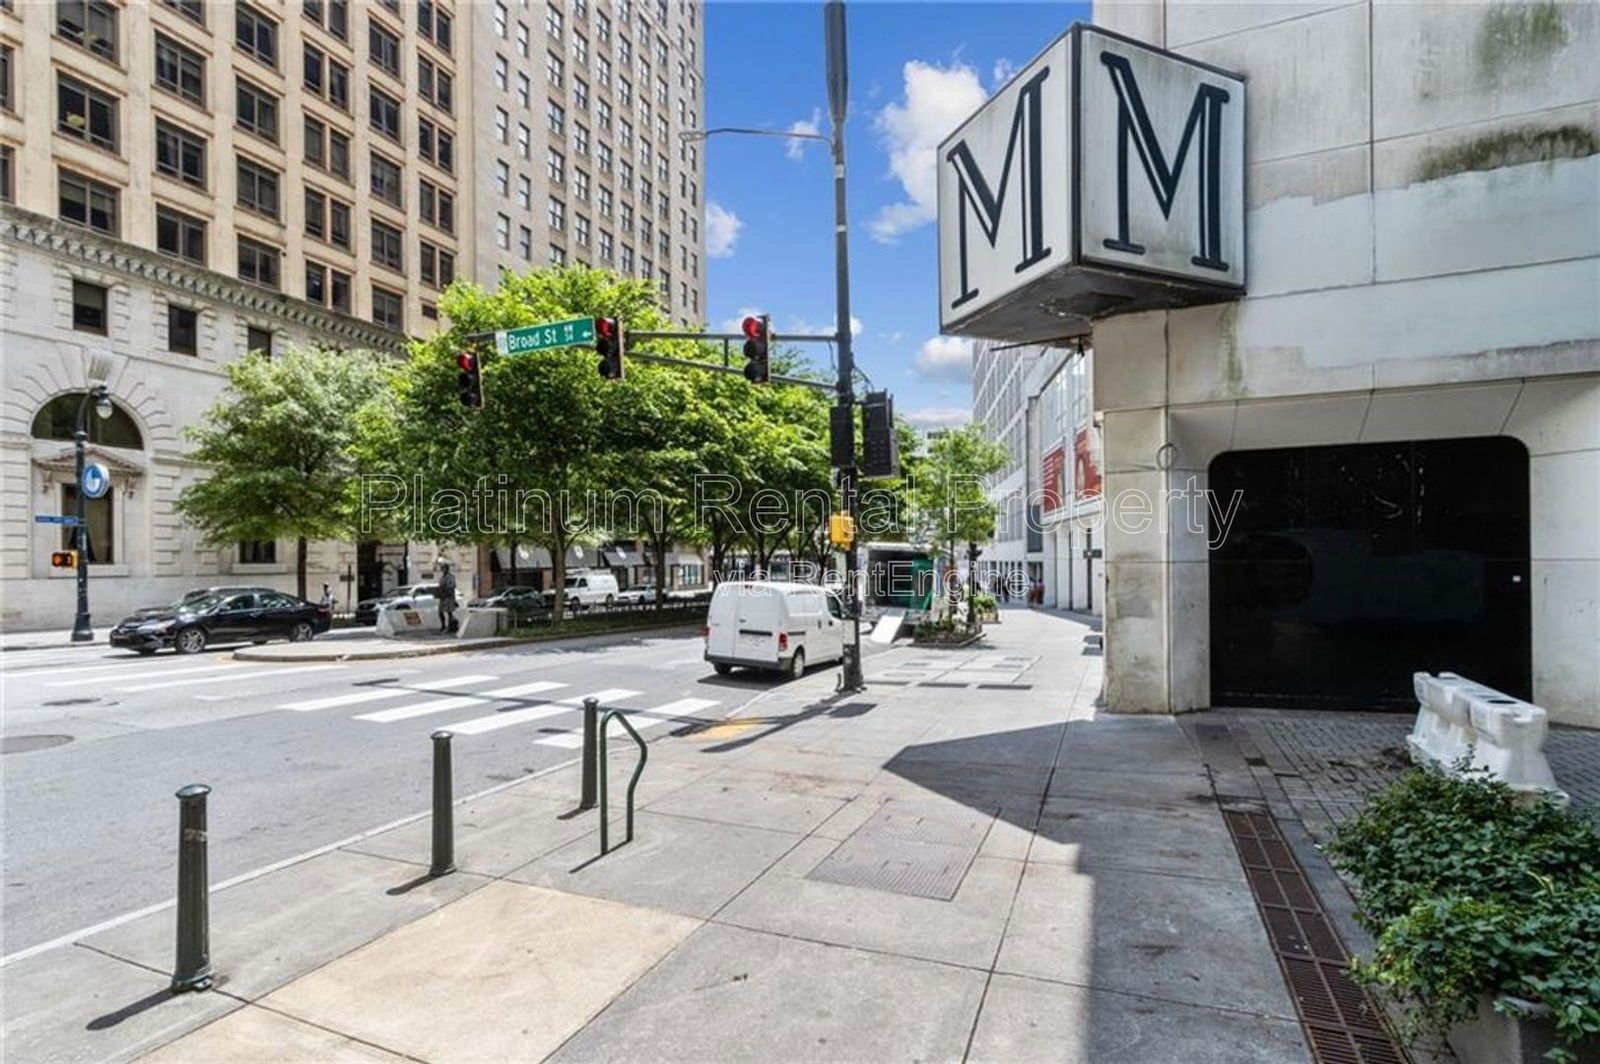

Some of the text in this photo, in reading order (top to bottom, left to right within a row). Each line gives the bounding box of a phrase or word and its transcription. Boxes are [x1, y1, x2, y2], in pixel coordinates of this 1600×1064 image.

[947, 66, 1051, 309] M
[1100, 51, 1230, 271] M
[509, 328, 557, 350] Broad St
